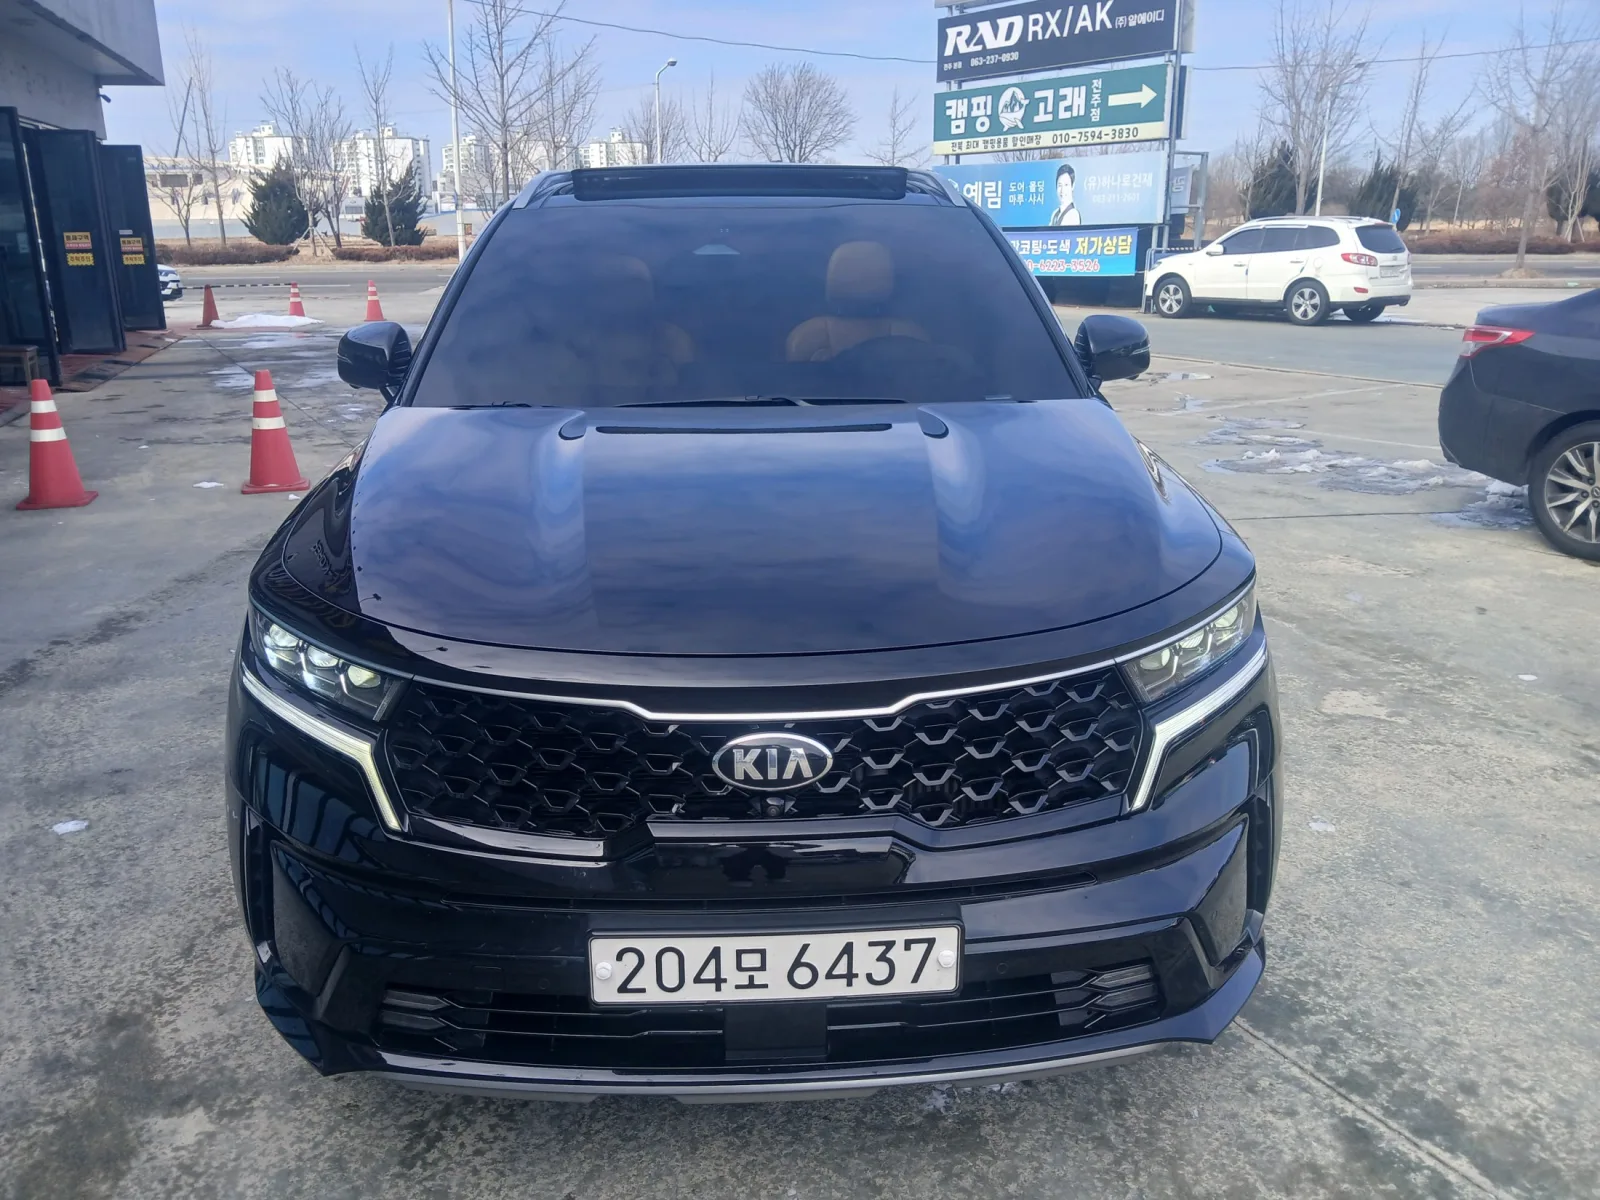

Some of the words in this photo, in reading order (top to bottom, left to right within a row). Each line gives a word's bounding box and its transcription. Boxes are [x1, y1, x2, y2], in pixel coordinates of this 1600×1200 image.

[944, 15, 1024, 56] RAD
[1028, 0, 1113, 42] RX/AK
[970, 51, 1019, 66] 063-237-0930
[946, 95, 992, 134] 캠핑
[1033, 86, 1086, 123] 고래
[1090, 78, 1102, 121] 전주점
[1052, 127, 1139, 144] 010-7594-3830
[963, 180, 1002, 209] 예림
[1074, 235, 1132, 255] 저가상담
[732, 748, 813, 780] KIA
[615, 946, 769, 994] 204모
[786, 937, 937, 989] 6437
